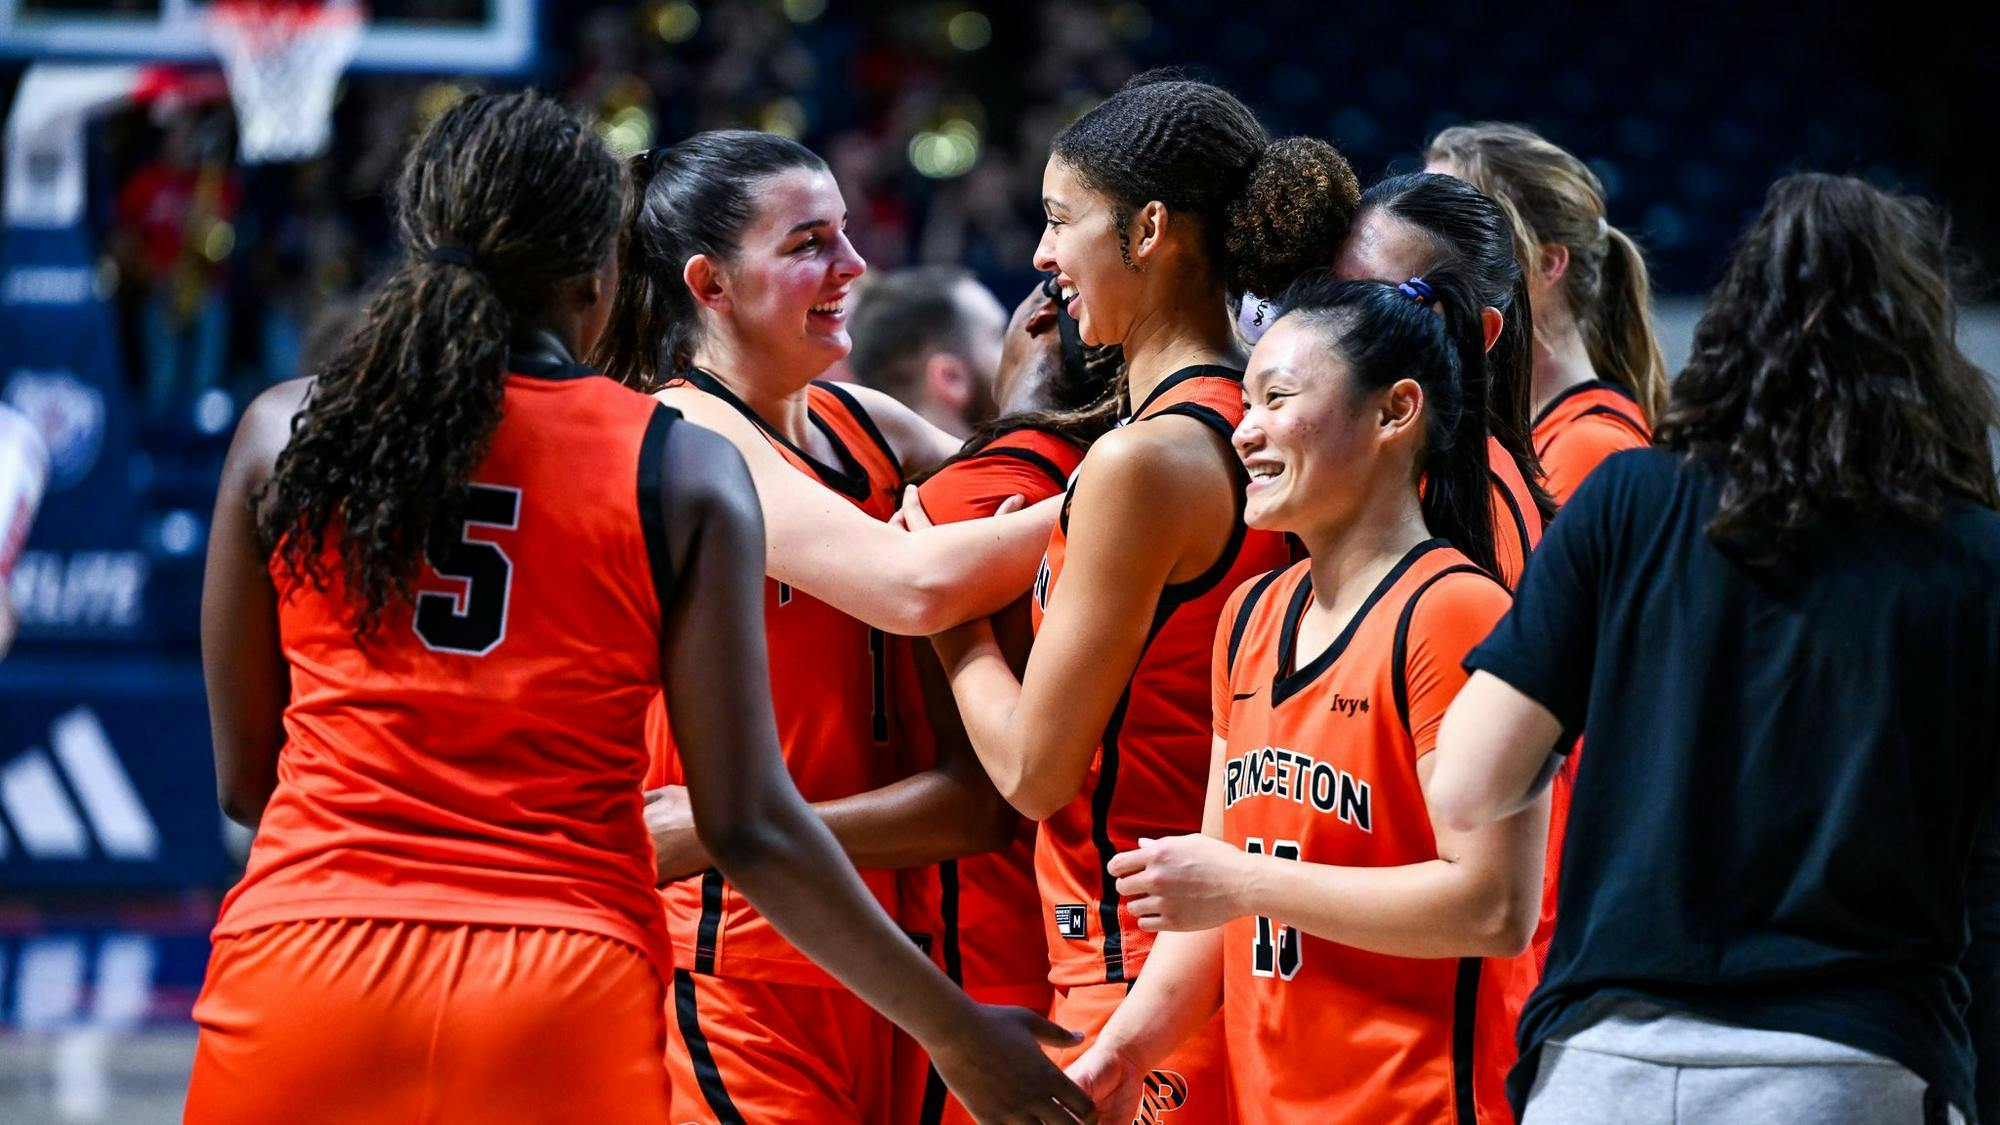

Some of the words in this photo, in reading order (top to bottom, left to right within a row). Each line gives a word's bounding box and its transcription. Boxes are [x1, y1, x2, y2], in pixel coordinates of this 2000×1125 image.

[412, 482, 523, 658] 5
[1331, 694, 1359, 717] Ivy
[1224, 746, 1372, 834] RINCETON
[1073, 915, 1081, 928] M
